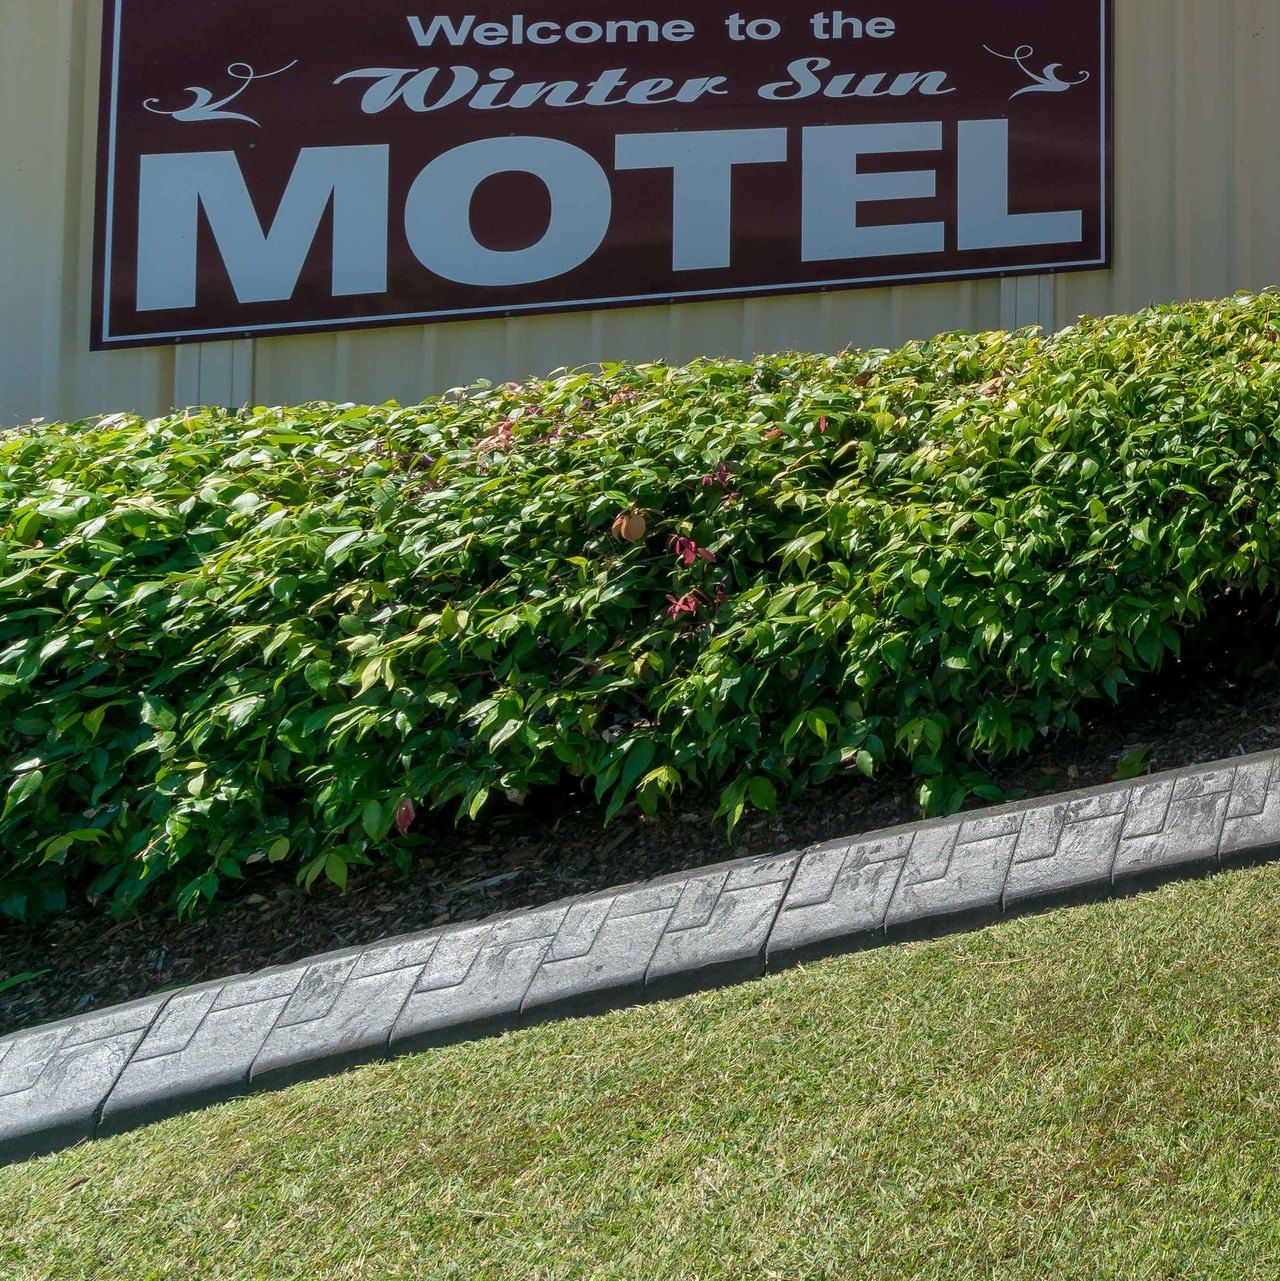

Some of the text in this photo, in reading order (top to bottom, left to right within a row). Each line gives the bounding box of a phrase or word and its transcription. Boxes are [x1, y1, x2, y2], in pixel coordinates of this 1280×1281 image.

[408, 11, 896, 46] Welcome to the
[333, 58, 956, 114] Winter Sun
[136, 118, 1083, 311] MOTEL
